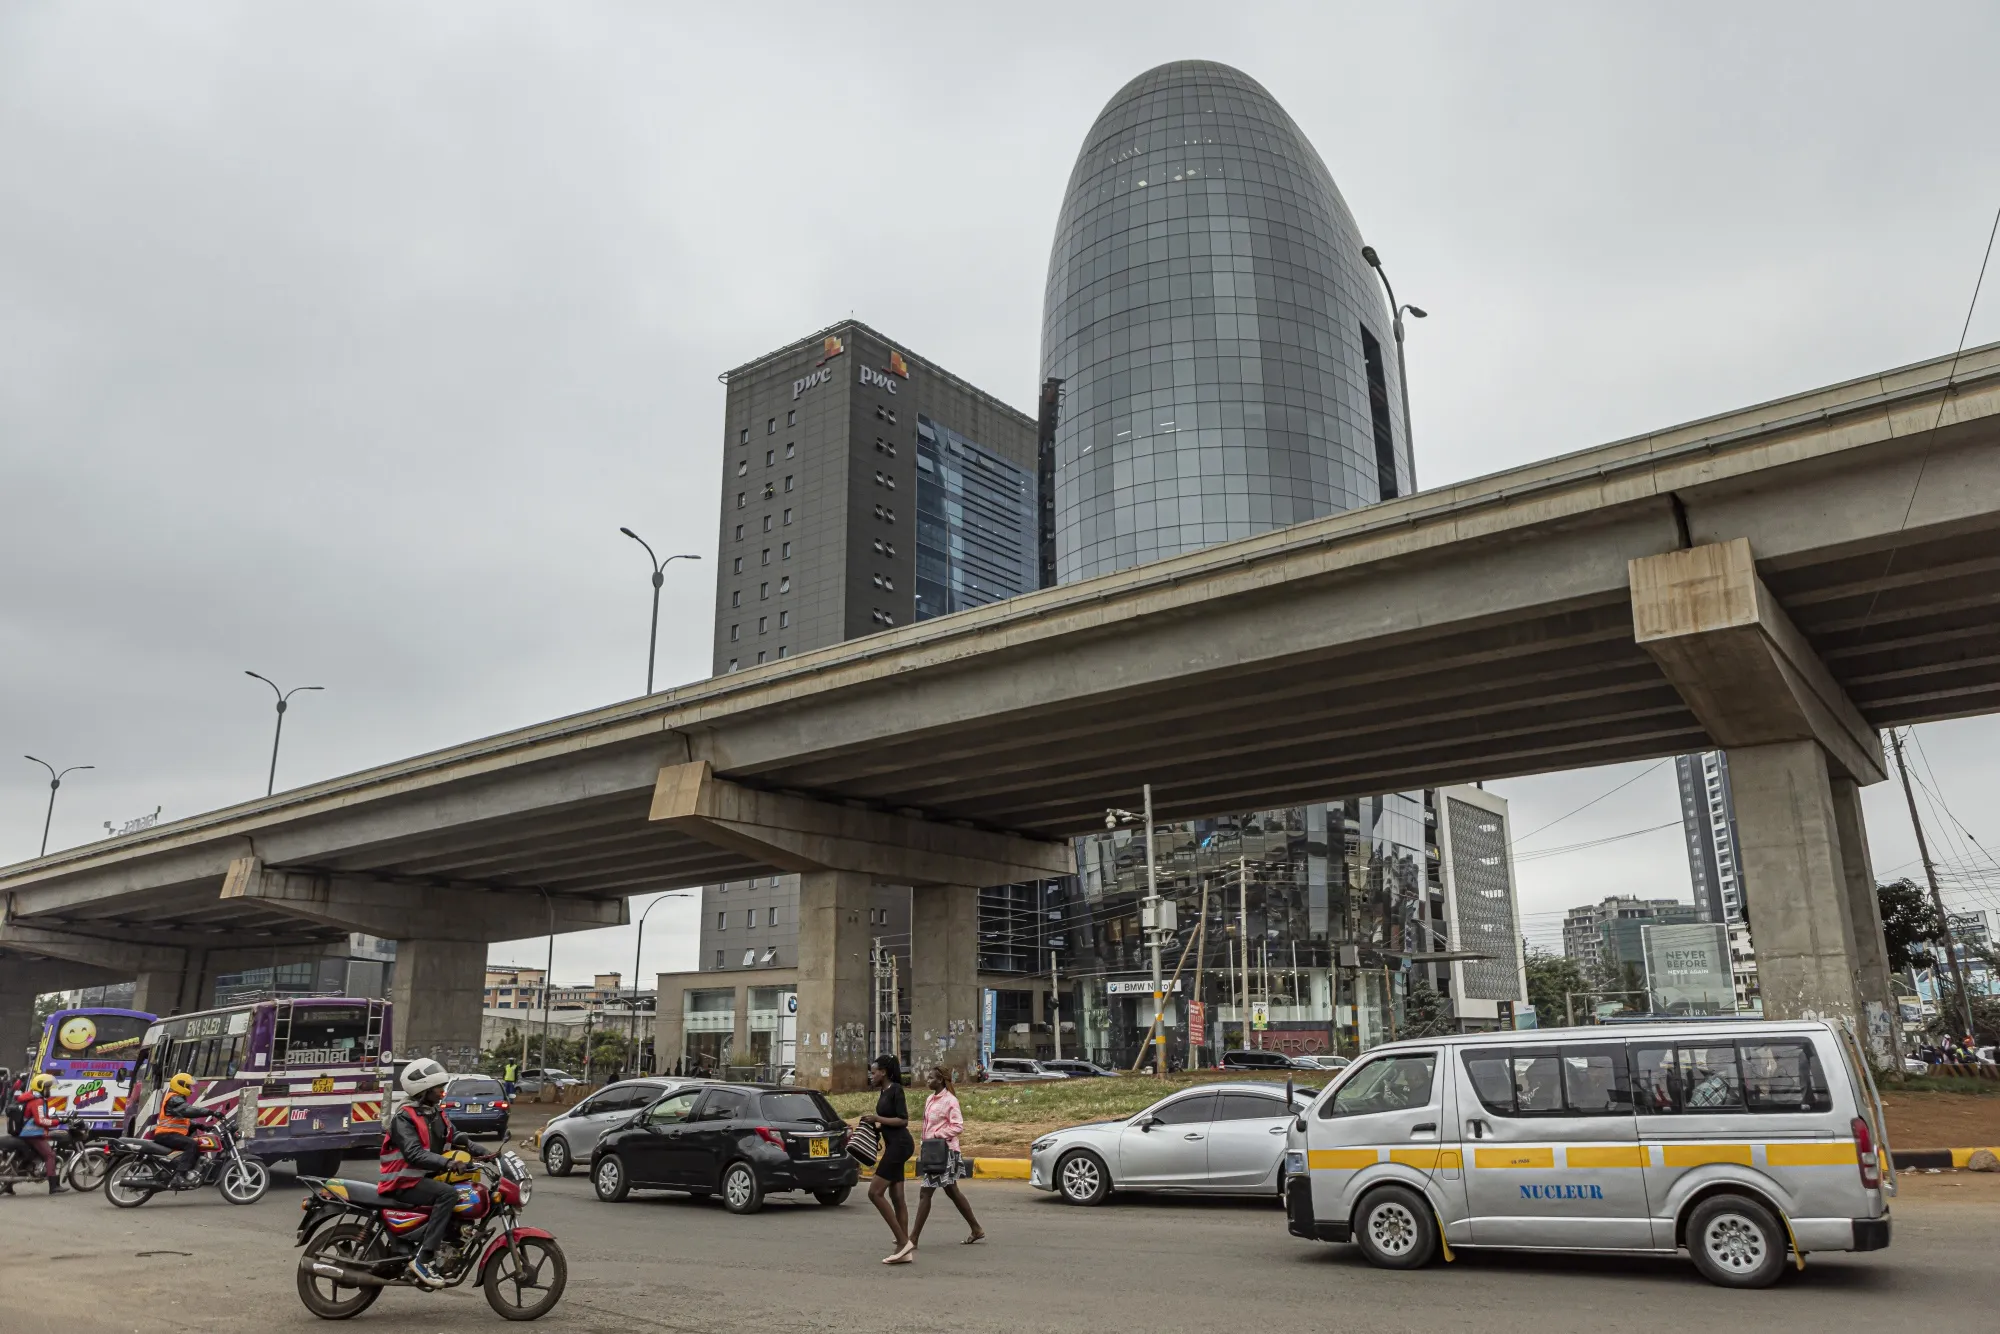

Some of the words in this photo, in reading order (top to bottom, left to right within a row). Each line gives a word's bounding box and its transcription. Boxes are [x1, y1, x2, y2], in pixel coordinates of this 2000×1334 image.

[793, 368, 832, 400] pwc
[859, 365, 897, 395] pwc
[1665, 950, 1706, 960] NEVER
[1667, 960, 1708, 968] BEFORE
[1124, 982, 1145, 992] BMW
[186, 1017, 221, 1037] ENBLED
[286, 1047, 350, 1065] enabled
[76, 1079, 103, 1095] GOD
[811, 1139, 823, 1147] KDE
[811, 1147, 828, 1156] 967N
[1519, 1184, 1604, 1200] NUCLEUR
